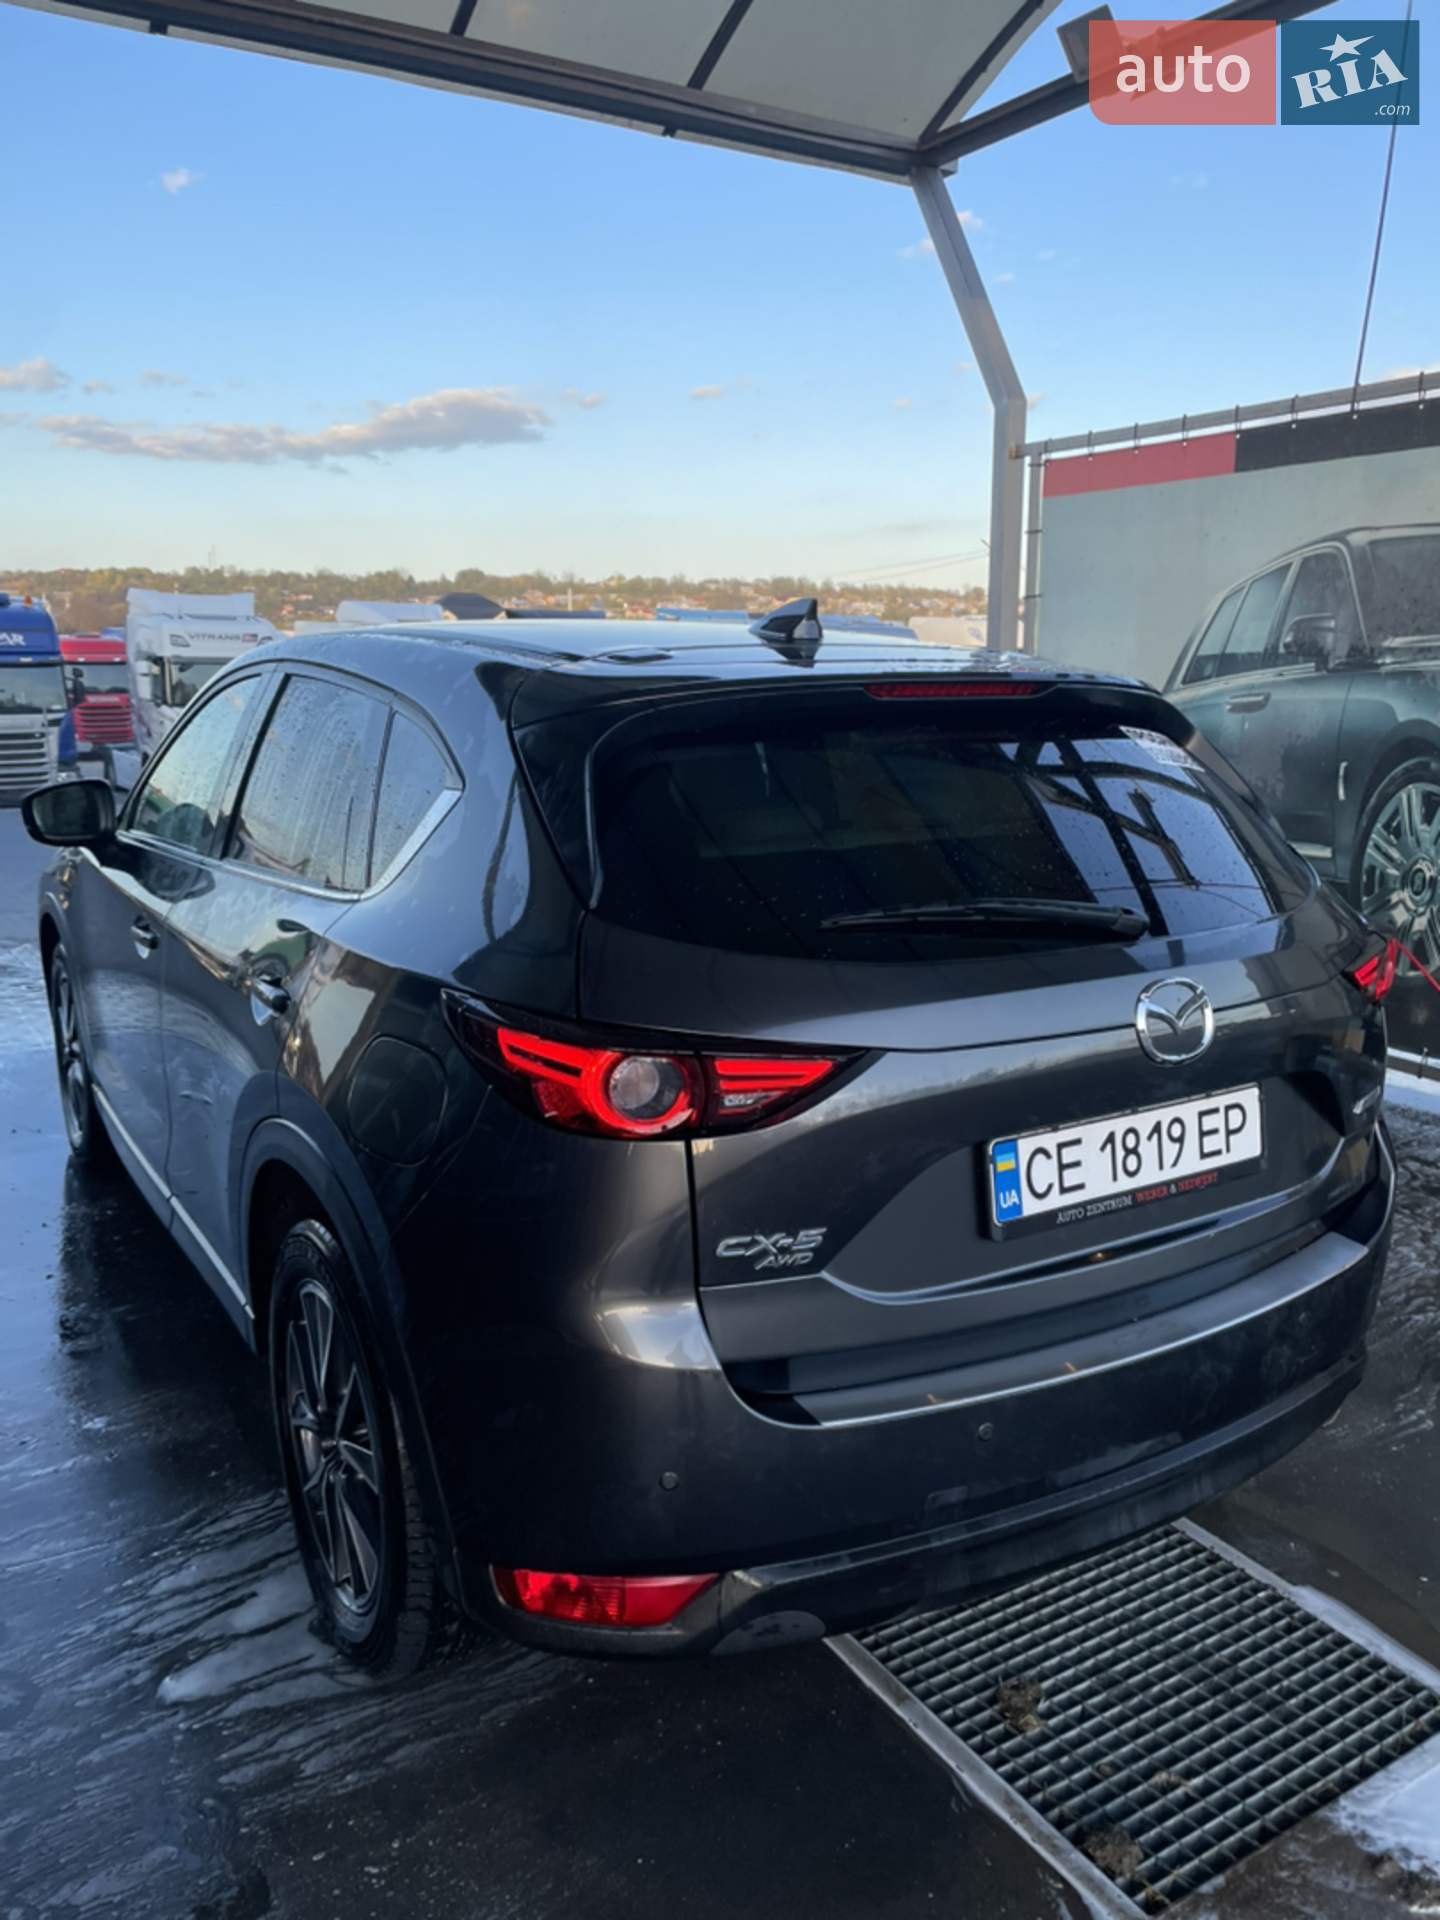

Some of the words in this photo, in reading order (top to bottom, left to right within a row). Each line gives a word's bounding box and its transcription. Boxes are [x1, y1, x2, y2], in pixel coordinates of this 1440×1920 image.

[188, 633, 240, 641] VITRANS
[1026, 1138, 1085, 1200] CE
[1100, 1116, 1186, 1182] 1819
[1197, 1102, 1247, 1160] EP
[1000, 1189, 1019, 1209] UA
[1056, 1207, 1085, 1224] AUTO
[1086, 1194, 1132, 1216] ZENTRUM
[1169, 1183, 1176, 1194] &
[716, 1227, 828, 1257] CX-5
[755, 1252, 814, 1270] AWD
